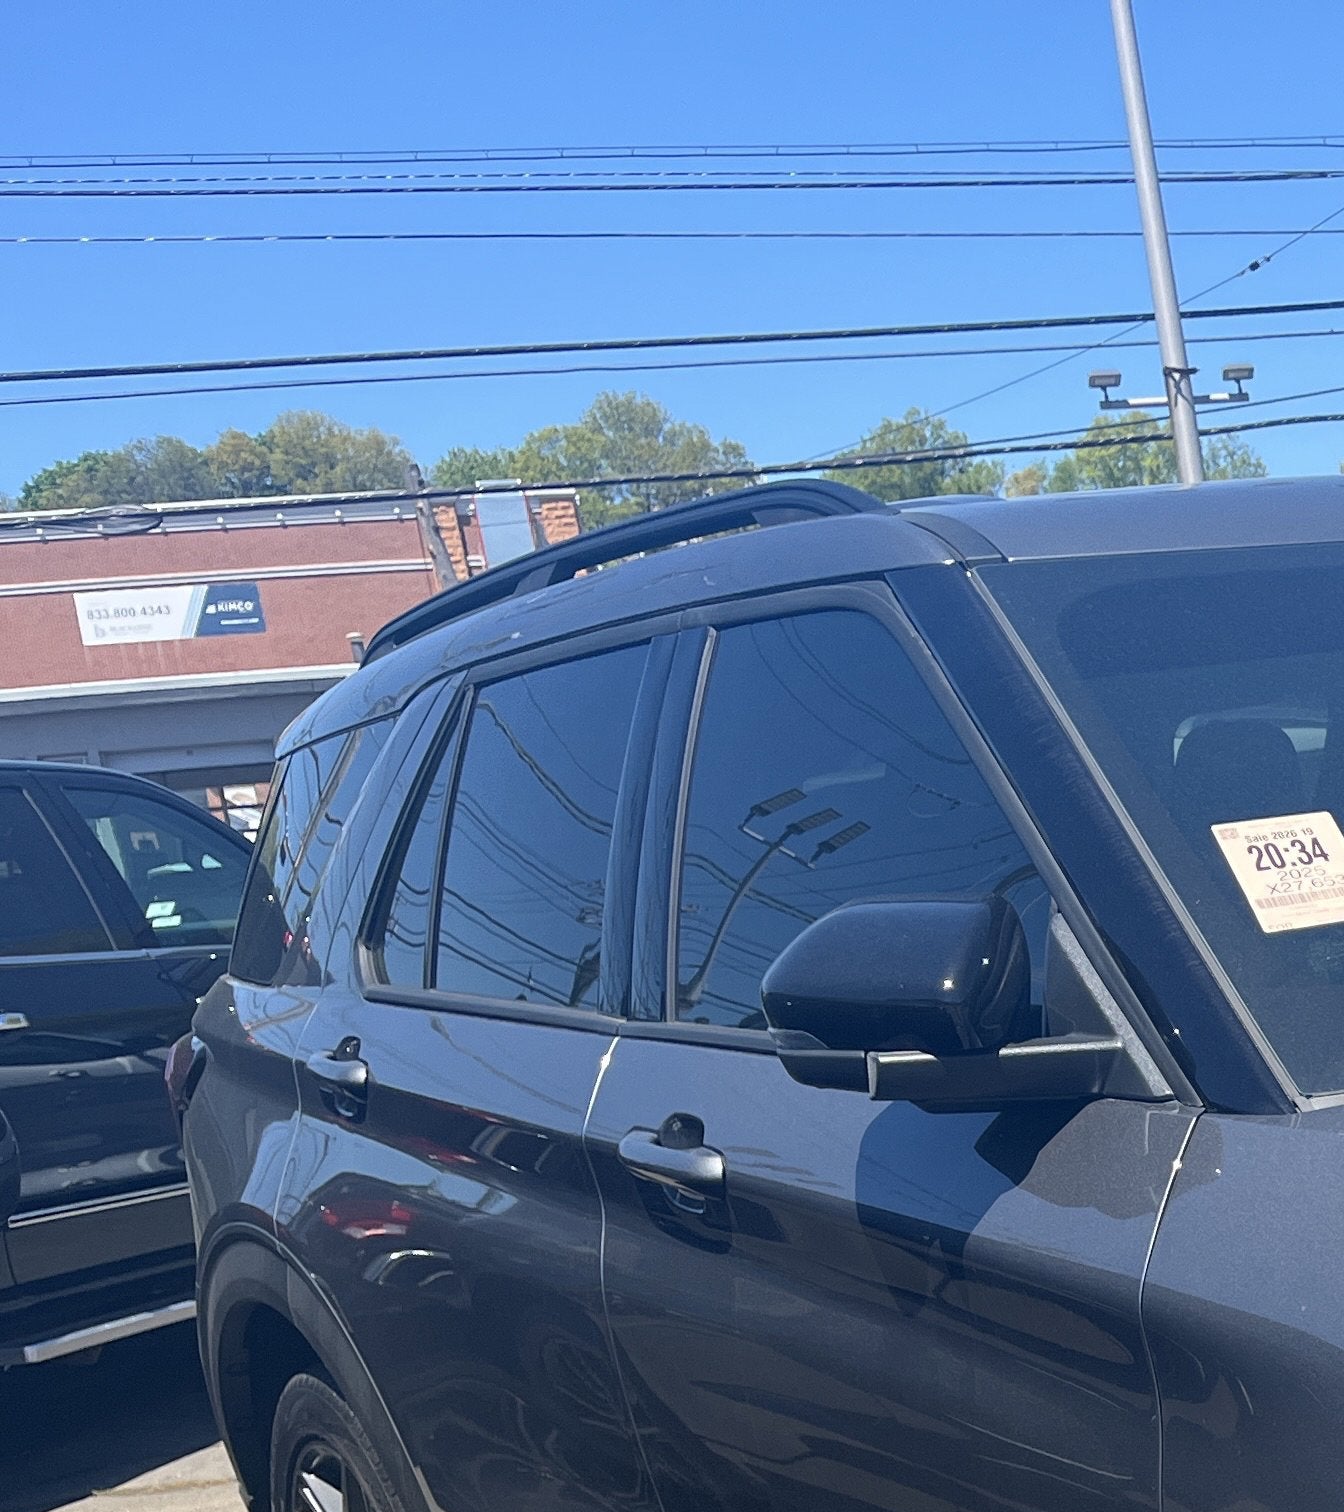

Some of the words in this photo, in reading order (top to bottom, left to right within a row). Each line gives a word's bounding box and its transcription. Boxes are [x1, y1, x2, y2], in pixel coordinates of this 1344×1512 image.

[217, 600, 255, 614] KIMCO
[1247, 837, 1330, 872] 20:34
[1276, 865, 1327, 882] 2025
